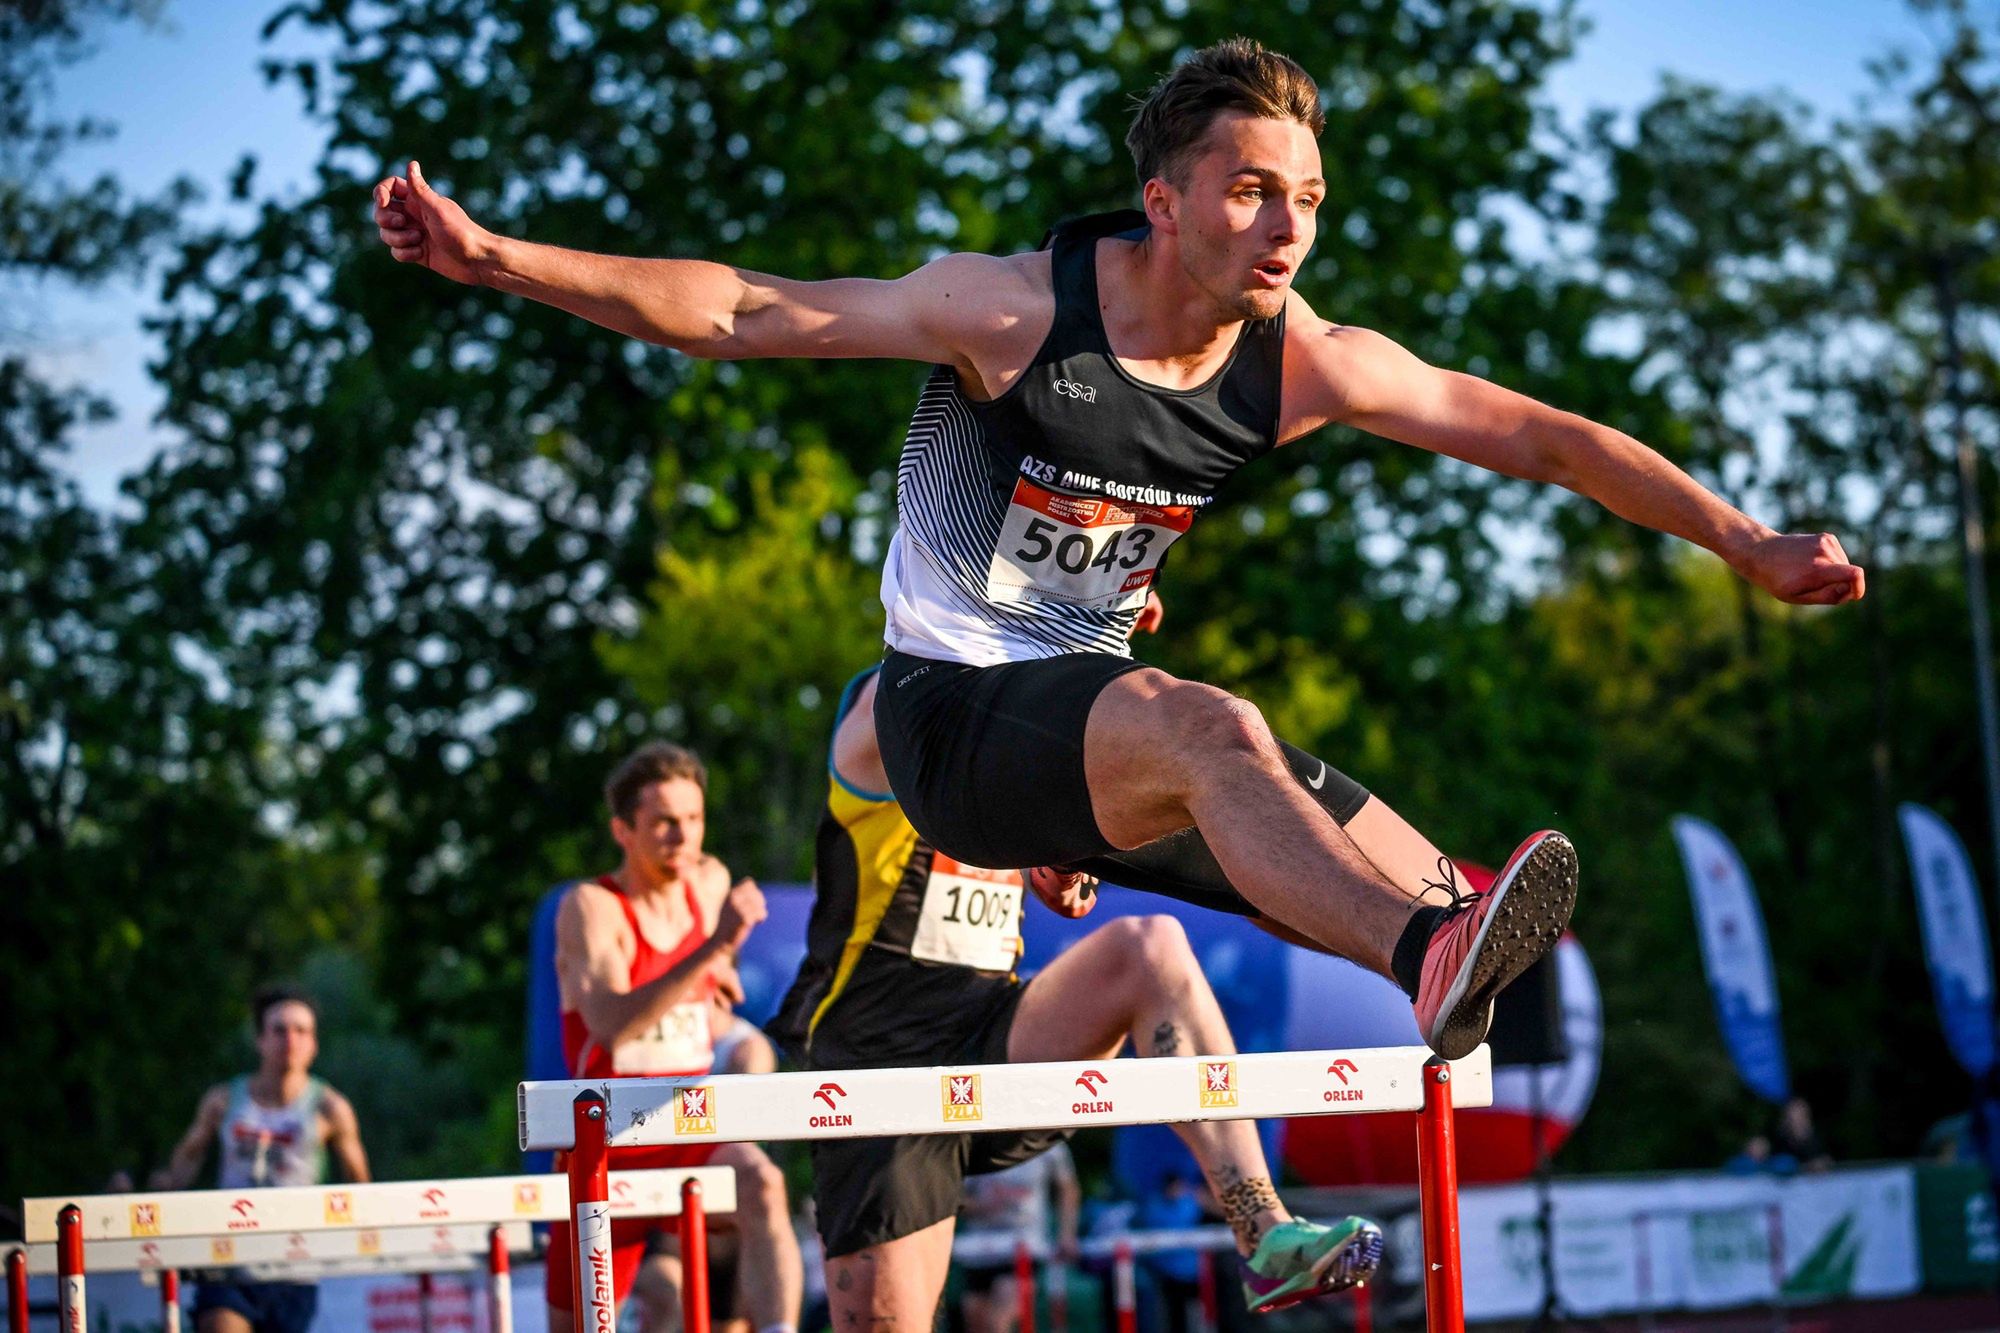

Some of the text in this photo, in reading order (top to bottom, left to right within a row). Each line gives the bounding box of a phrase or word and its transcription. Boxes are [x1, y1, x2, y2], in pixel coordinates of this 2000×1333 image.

[1020, 455, 1057, 483] AZS
[1015, 517, 1156, 575] 5043
[896, 664, 931, 688] DRI-FIT
[942, 886, 1012, 929] 1009
[1201, 1091, 1236, 1105] PZLA
[1323, 1089, 1363, 1102] ORLEN
[944, 1105, 980, 1119] PZLA
[1071, 1101, 1113, 1114] ORLEN
[675, 1118, 714, 1132] PZLA
[809, 1114, 853, 1128] ORLEN
